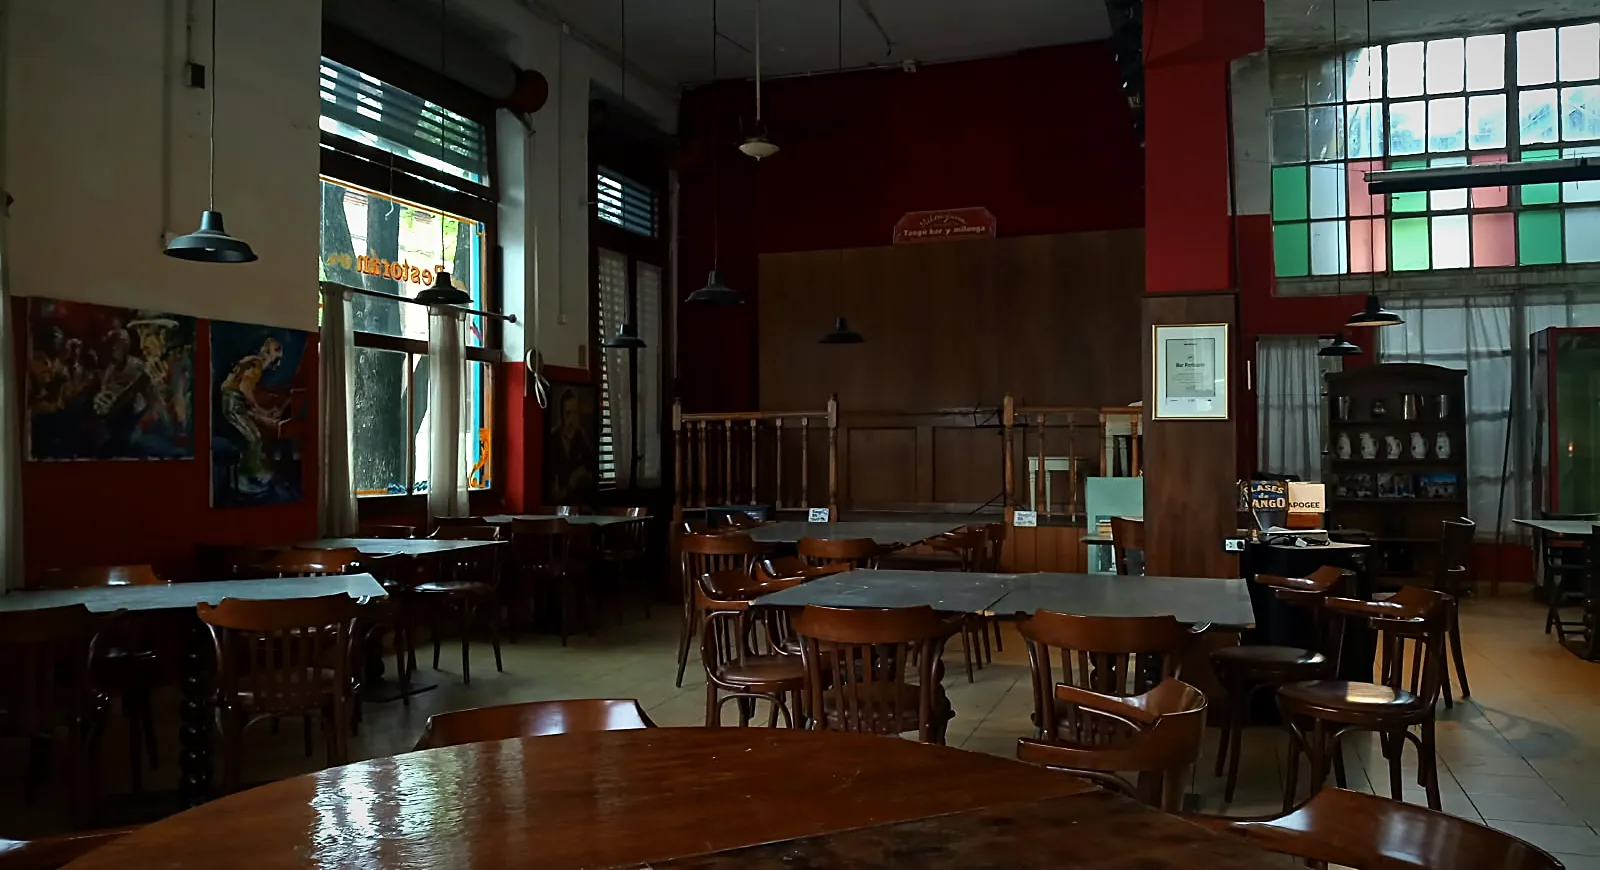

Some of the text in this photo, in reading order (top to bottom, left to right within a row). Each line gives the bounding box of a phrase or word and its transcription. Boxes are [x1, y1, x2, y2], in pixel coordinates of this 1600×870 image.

[903, 229, 928, 237] Tango
[945, 228, 951, 236] y
[953, 225, 986, 234] milonga
